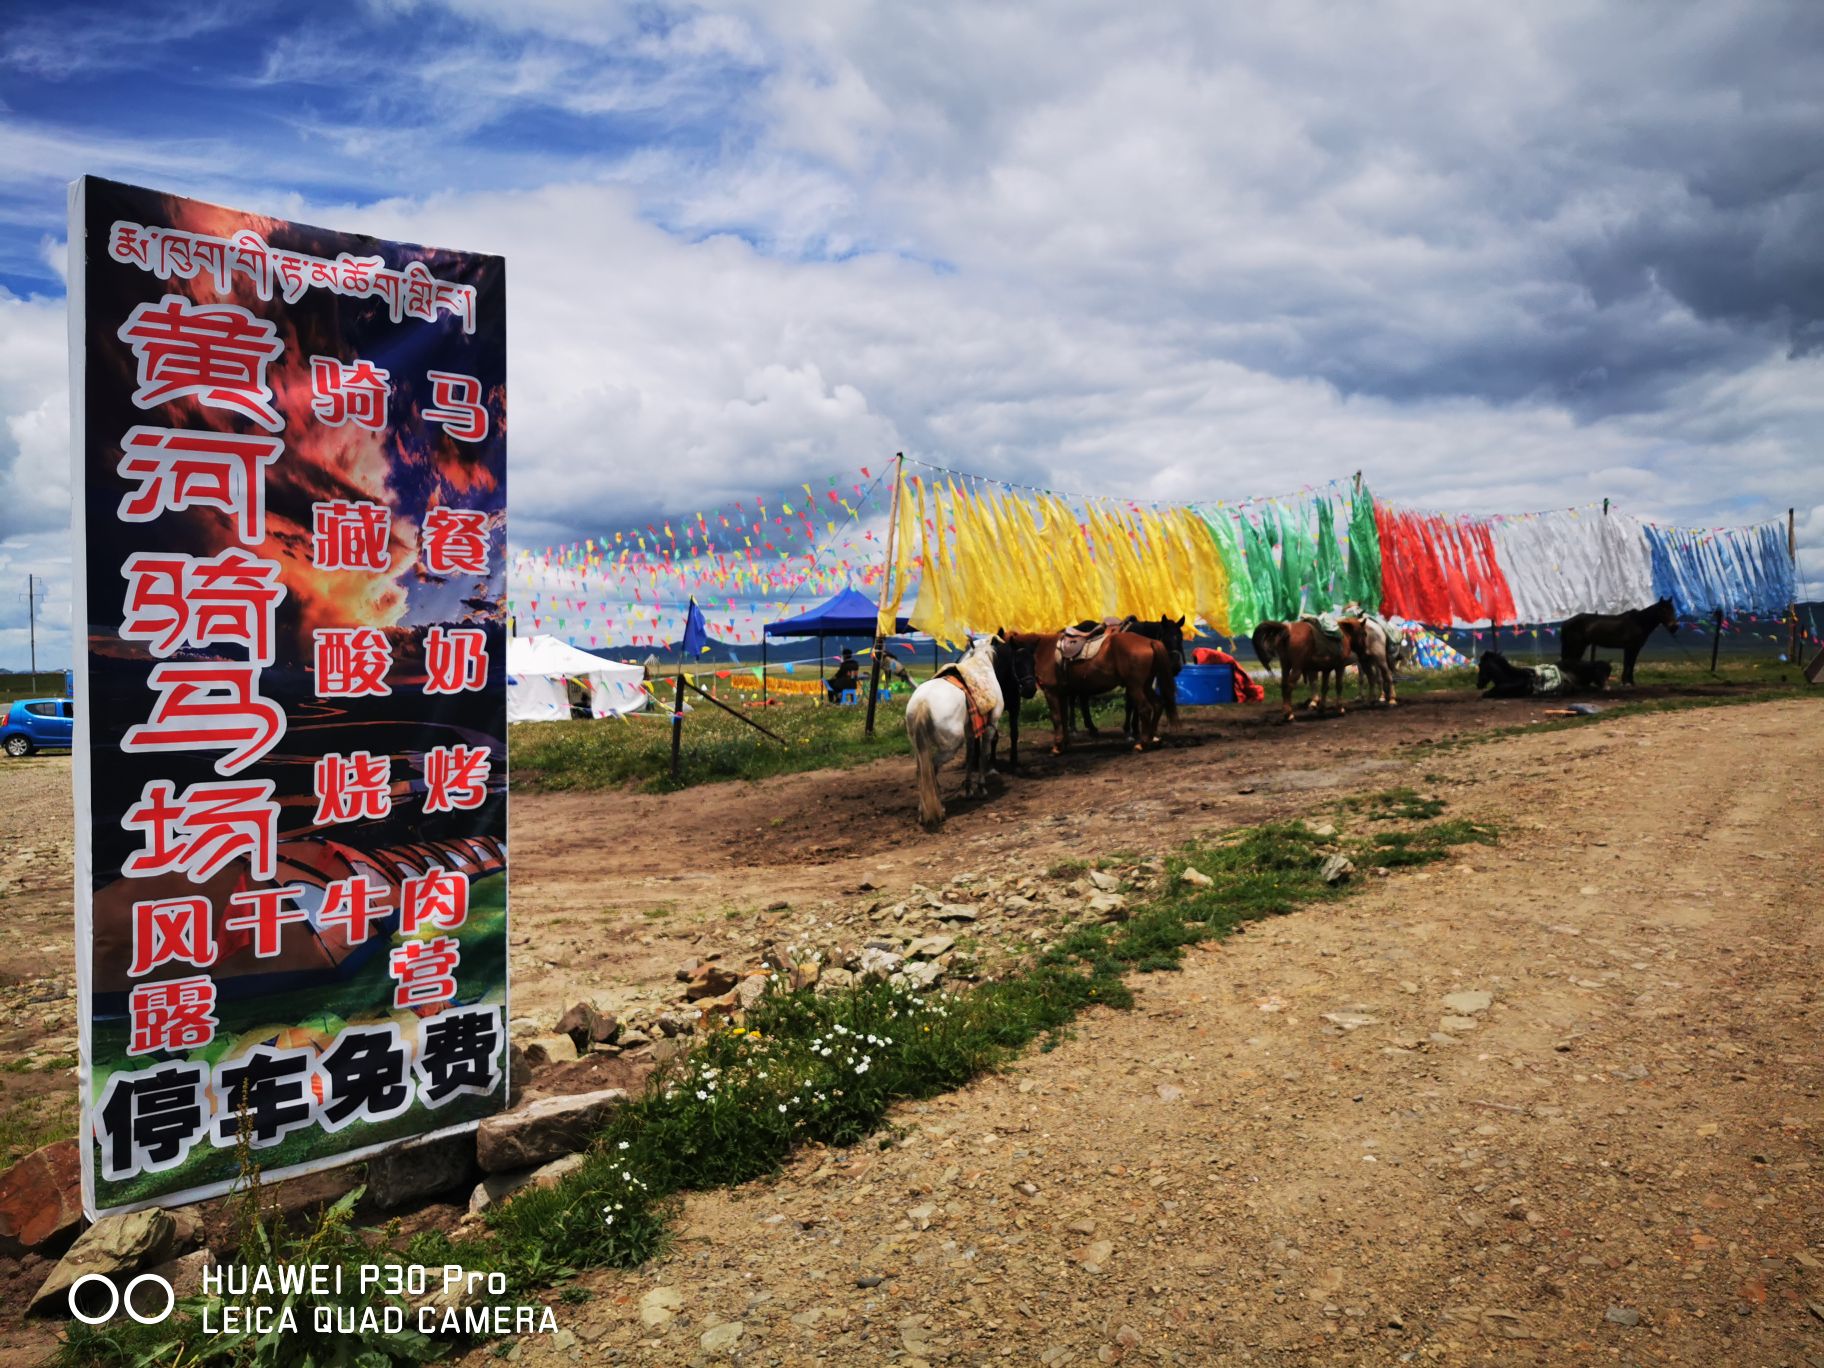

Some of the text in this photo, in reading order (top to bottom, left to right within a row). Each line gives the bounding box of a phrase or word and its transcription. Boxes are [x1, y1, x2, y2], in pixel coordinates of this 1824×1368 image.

[311, 358, 486, 440] 骑马
[313, 502, 489, 573] 藏餐
[126, 301, 284, 876] 黄河骑马场
[316, 628, 487, 695] 酸奶
[315, 747, 489, 823] 烧烤
[131, 869, 467, 976] 风干牛肉
[101, 1012, 499, 1173] 停车免费
